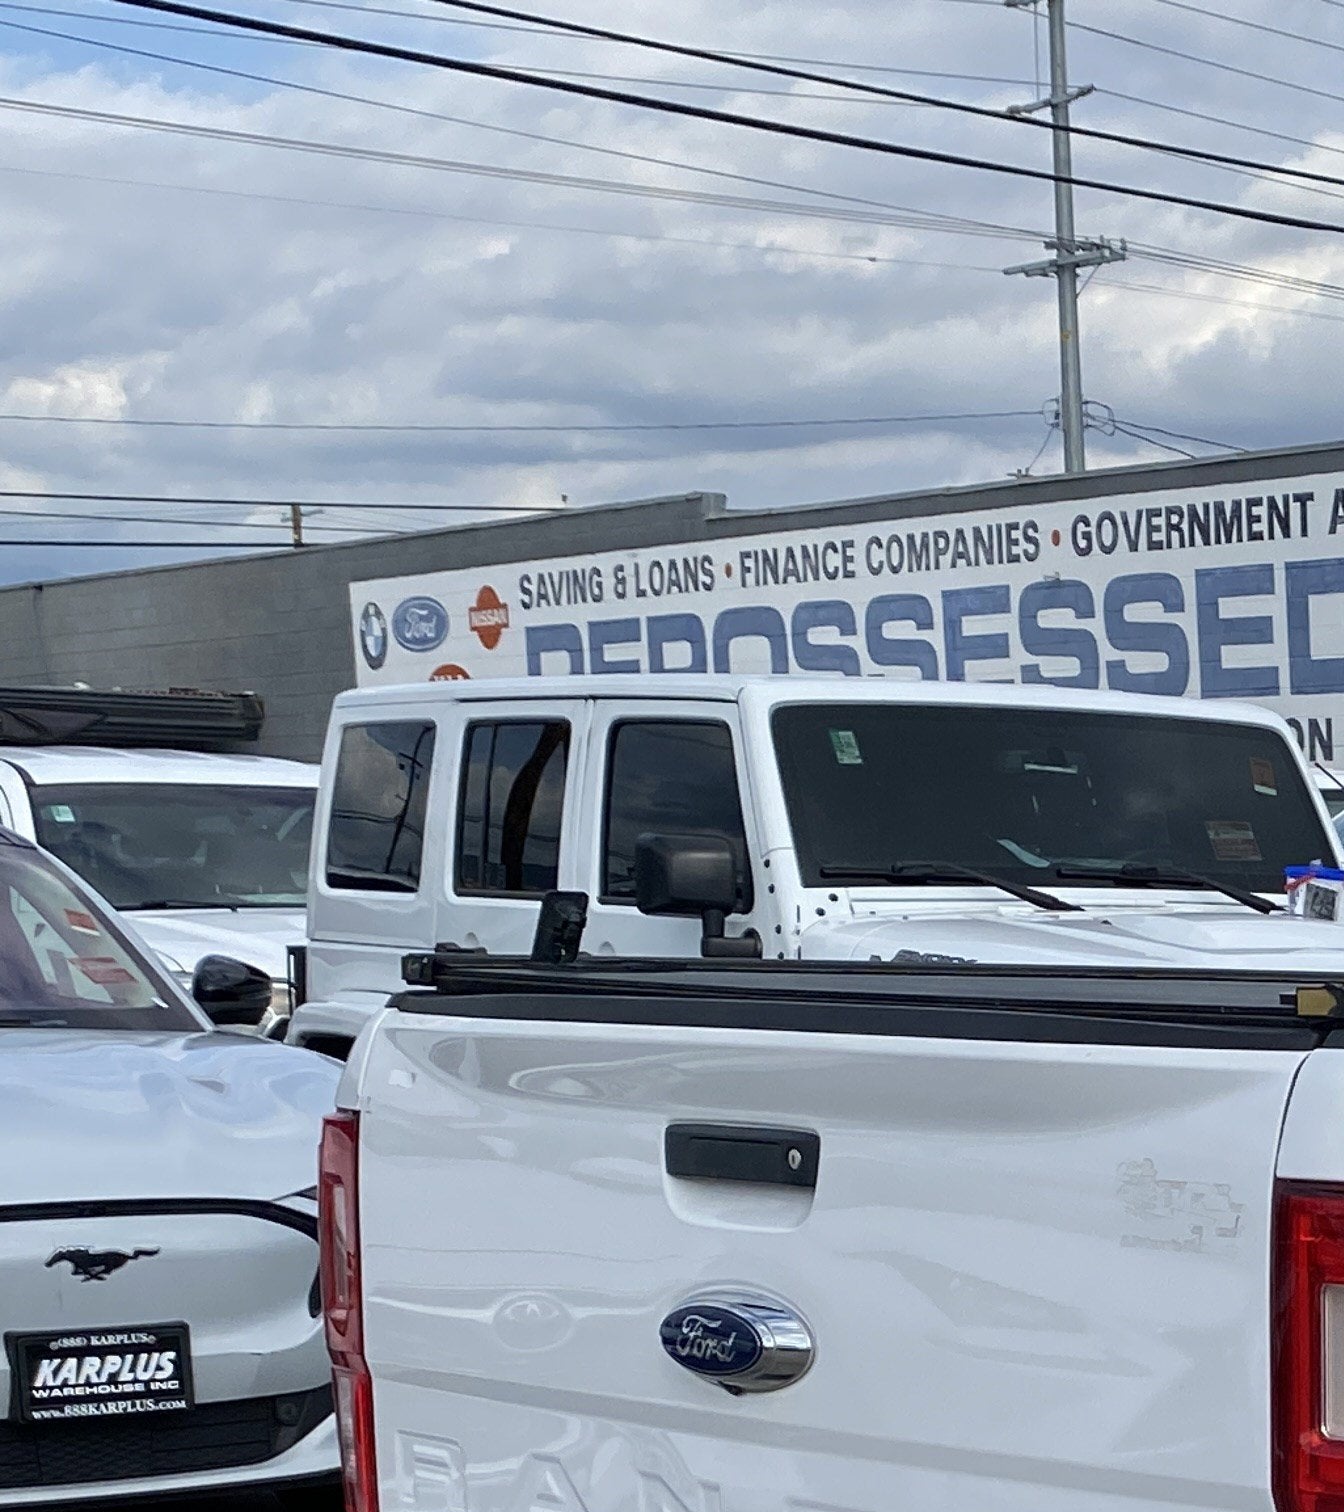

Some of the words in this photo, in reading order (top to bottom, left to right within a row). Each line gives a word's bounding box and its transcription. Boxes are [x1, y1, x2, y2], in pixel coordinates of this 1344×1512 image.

[519, 566, 604, 609] SAVING
[614, 564, 627, 600] &
[636, 555, 714, 599] LOANS
[740, 539, 855, 588] FINANCE
[865, 519, 1041, 577] COMPANIES
[1070, 491, 1314, 557] GOVERNMENT
[90, 1332, 148, 1347] KARPLUS
[676, 1314, 737, 1363] Ford
[33, 1351, 177, 1388] KARPLUS
[32, 1382, 145, 1399] WAREHOUSE
[150, 1380, 180, 1390] INC
